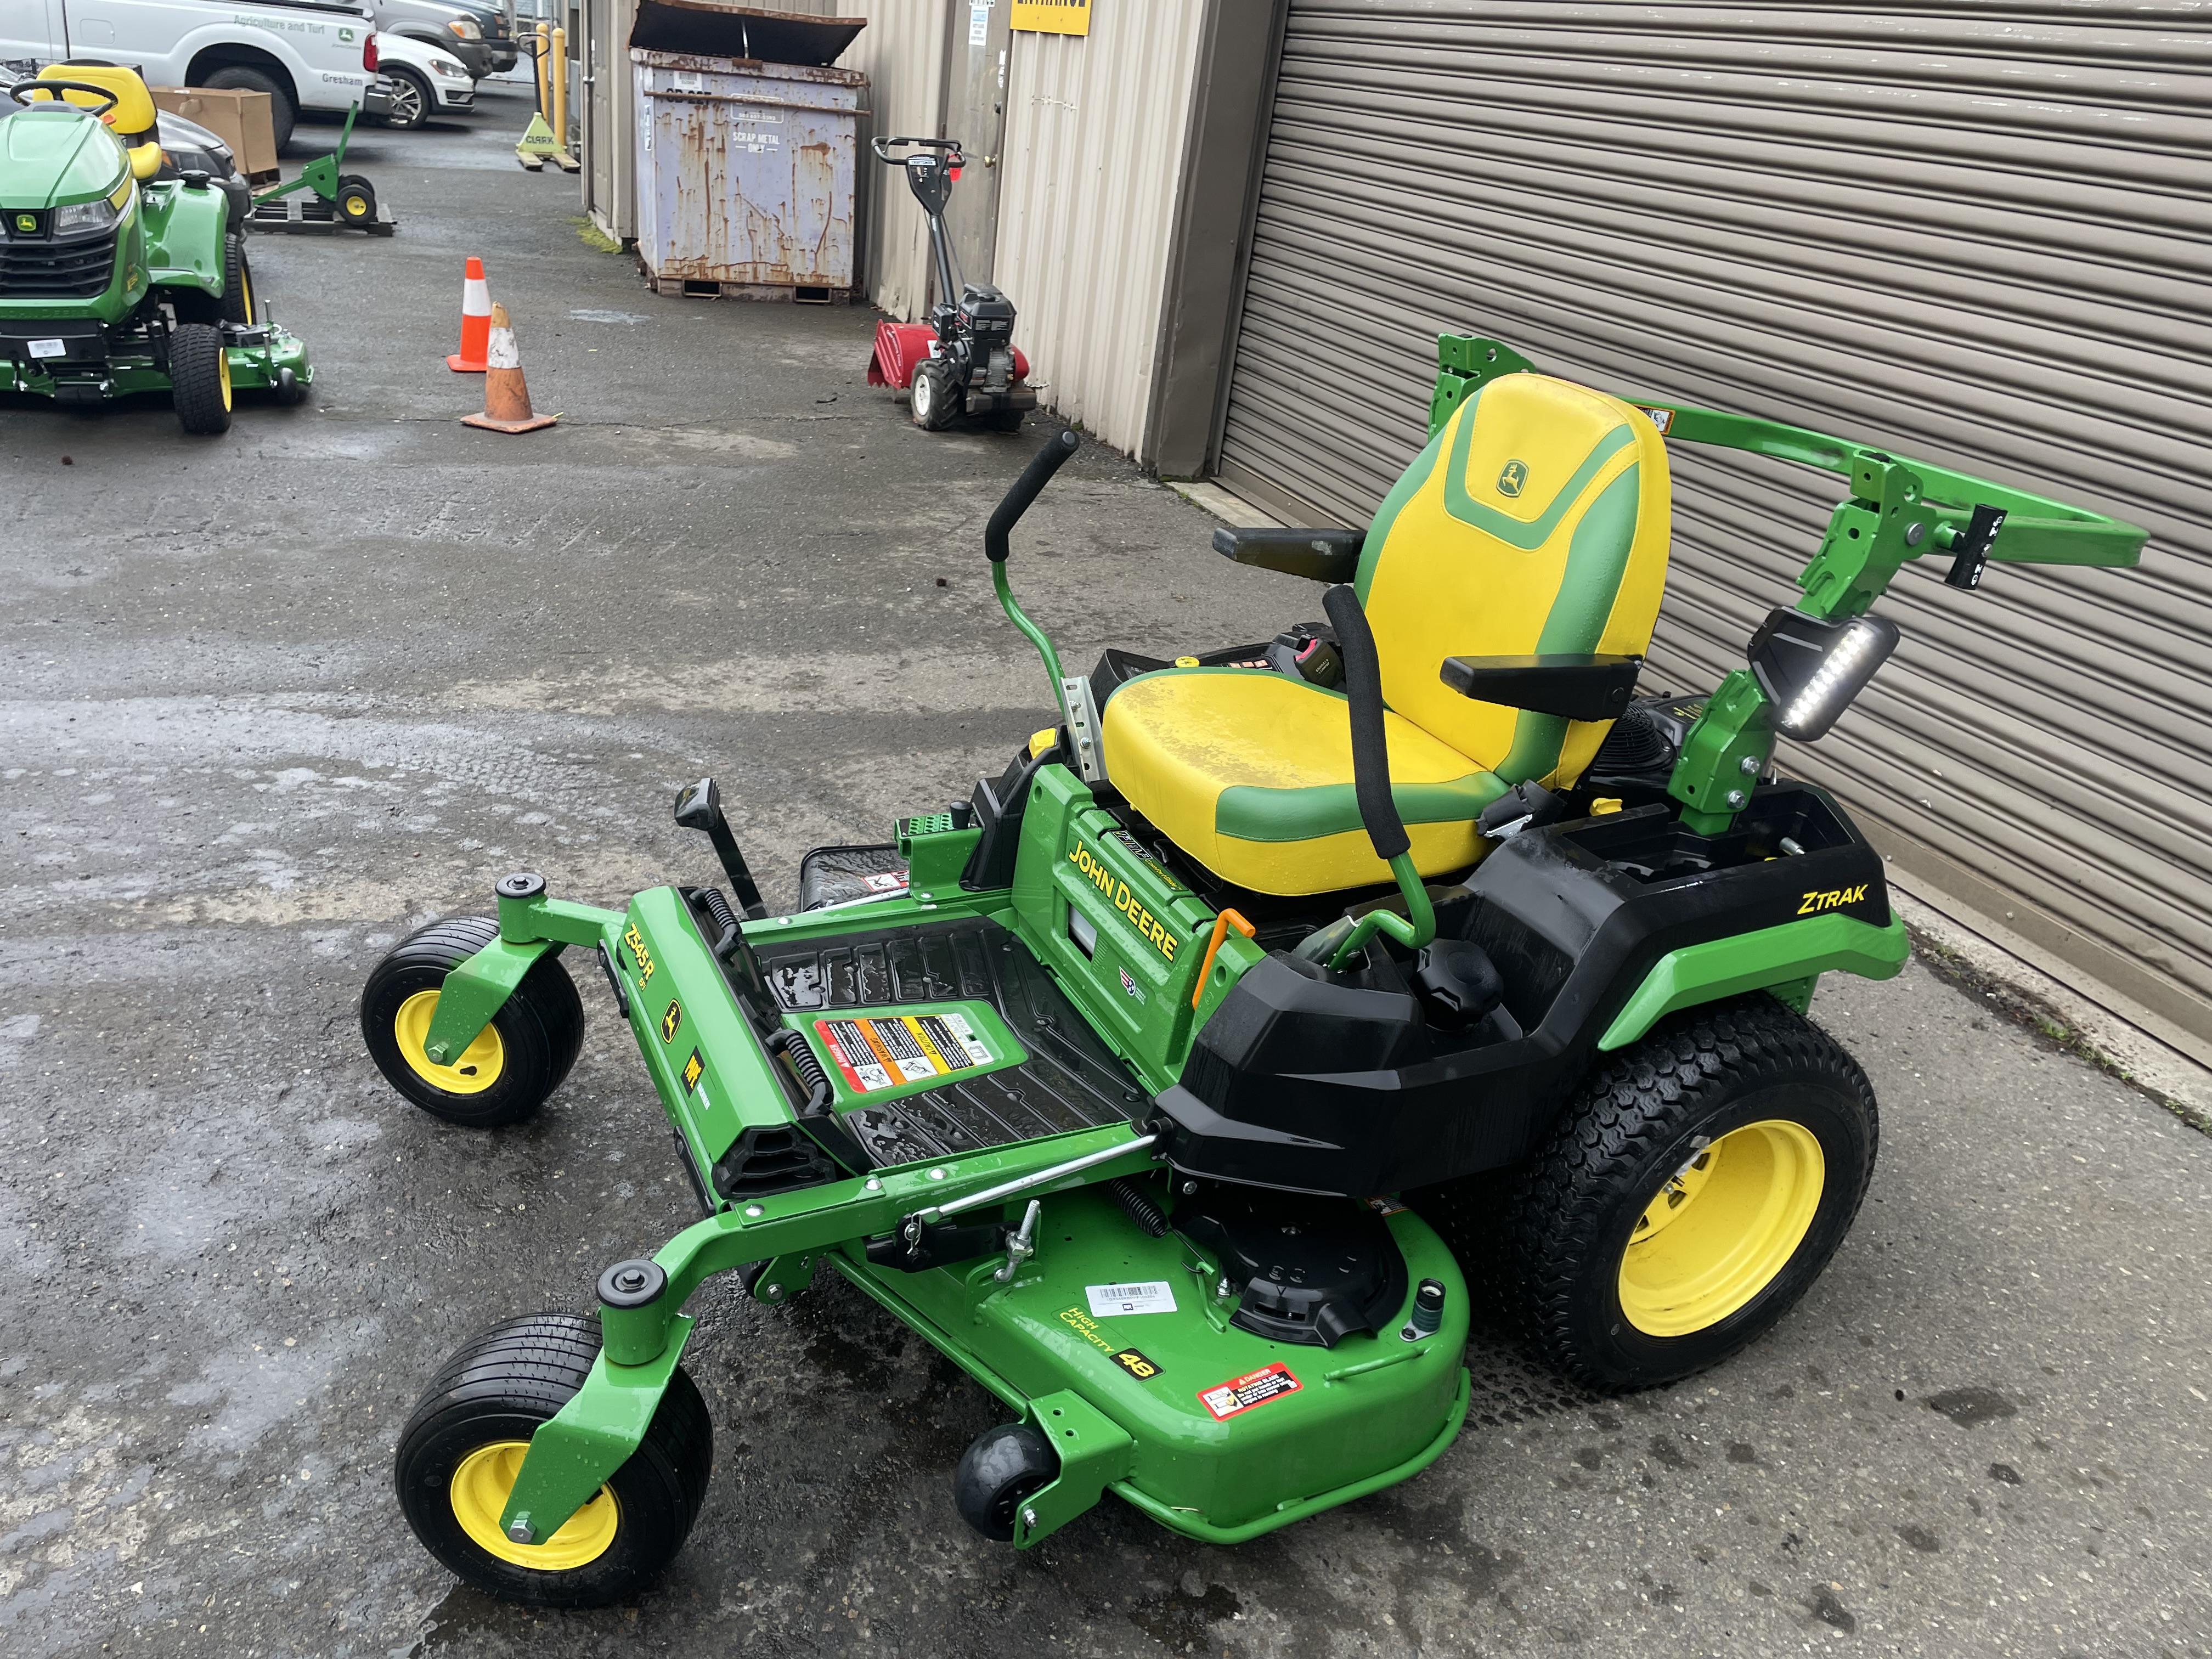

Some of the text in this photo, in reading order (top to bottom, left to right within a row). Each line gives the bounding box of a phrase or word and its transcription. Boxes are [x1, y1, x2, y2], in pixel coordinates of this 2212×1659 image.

[234, 15, 325, 35] Agriculture and Turf
[322, 73, 363, 86] Gresham
[526, 136, 554, 144] CLARK
[732, 131, 780, 145] SCRAP METAL
[747, 143, 765, 154] ONLY
[1068, 839, 1115, 899] JOHN
[1114, 880, 1178, 962] DEERE
[1797, 884, 1869, 915] ZTRAK
[916, 1032, 934, 1051] CAUTION
[829, 1044, 845, 1063] DANGER
[1068, 1307, 1099, 1330] HIGH
[1059, 1312, 1115, 1352] CAPACITY
[1119, 1353, 1155, 1377] 48
[1244, 1368, 1272, 1383] DANGER
